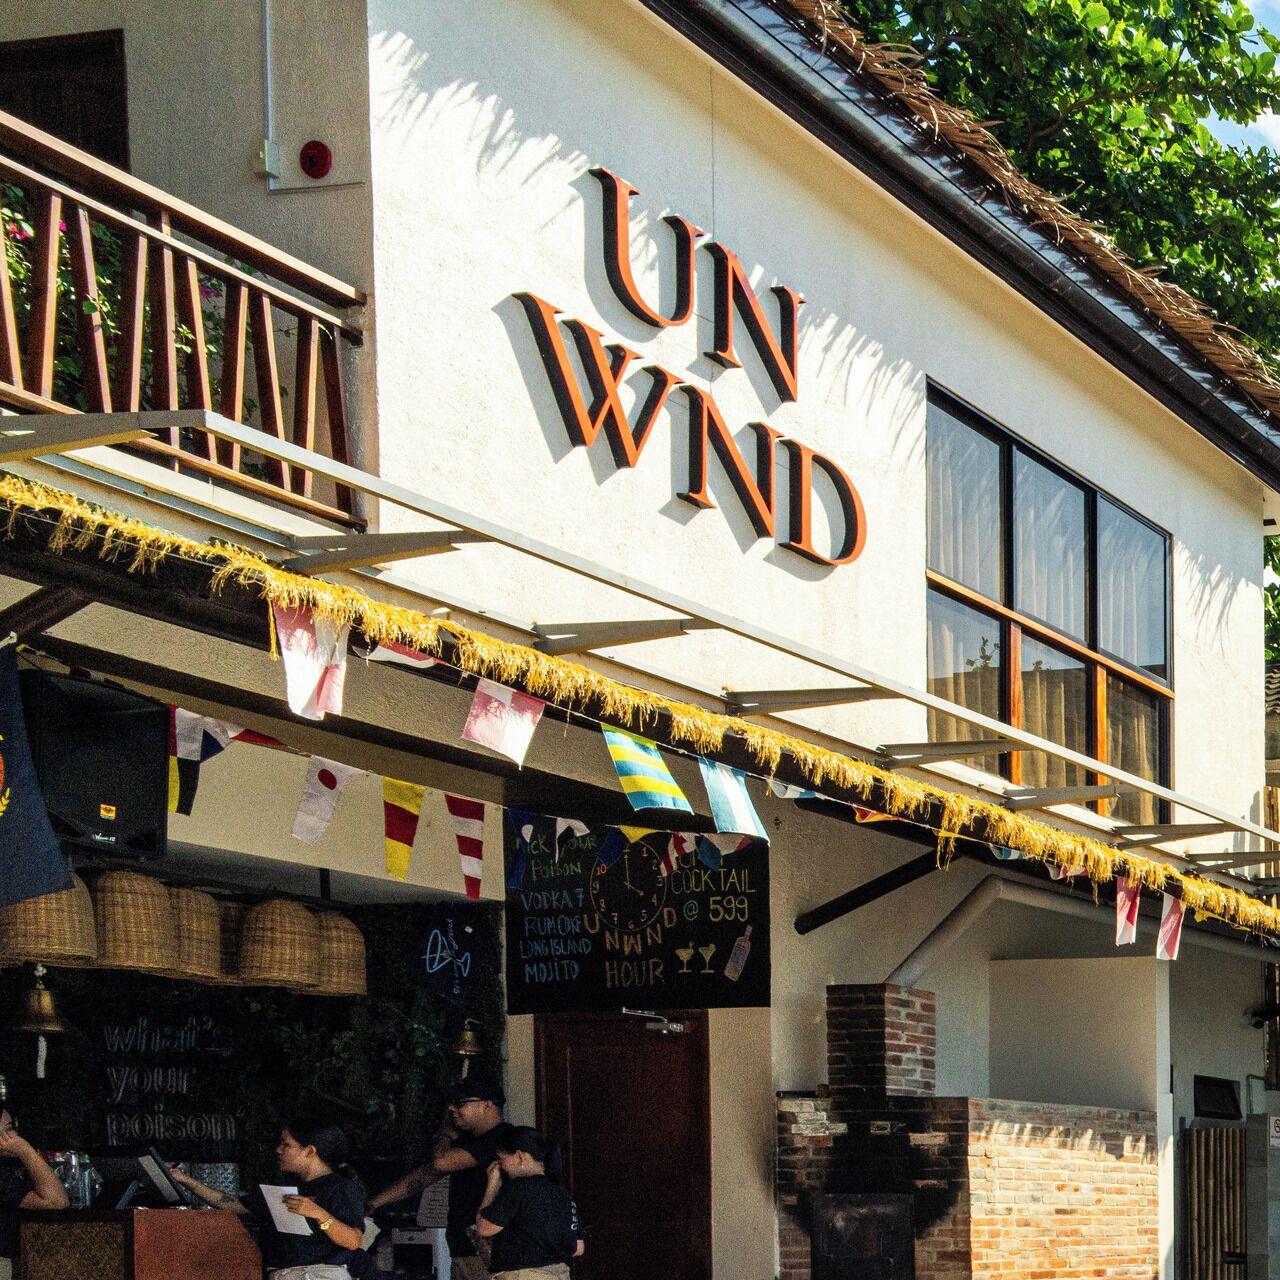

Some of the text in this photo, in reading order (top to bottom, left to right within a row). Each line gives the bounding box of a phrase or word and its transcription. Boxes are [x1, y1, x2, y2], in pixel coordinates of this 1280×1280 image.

[587, 167, 806, 402] UN
[511, 291, 867, 566] WND
[520, 889, 573, 912] VODKA
[683, 896, 749, 922] @ 599
[524, 916, 556, 938] RUM
[550, 937, 591, 956] ISLAND
[605, 959, 665, 988] HOUR
